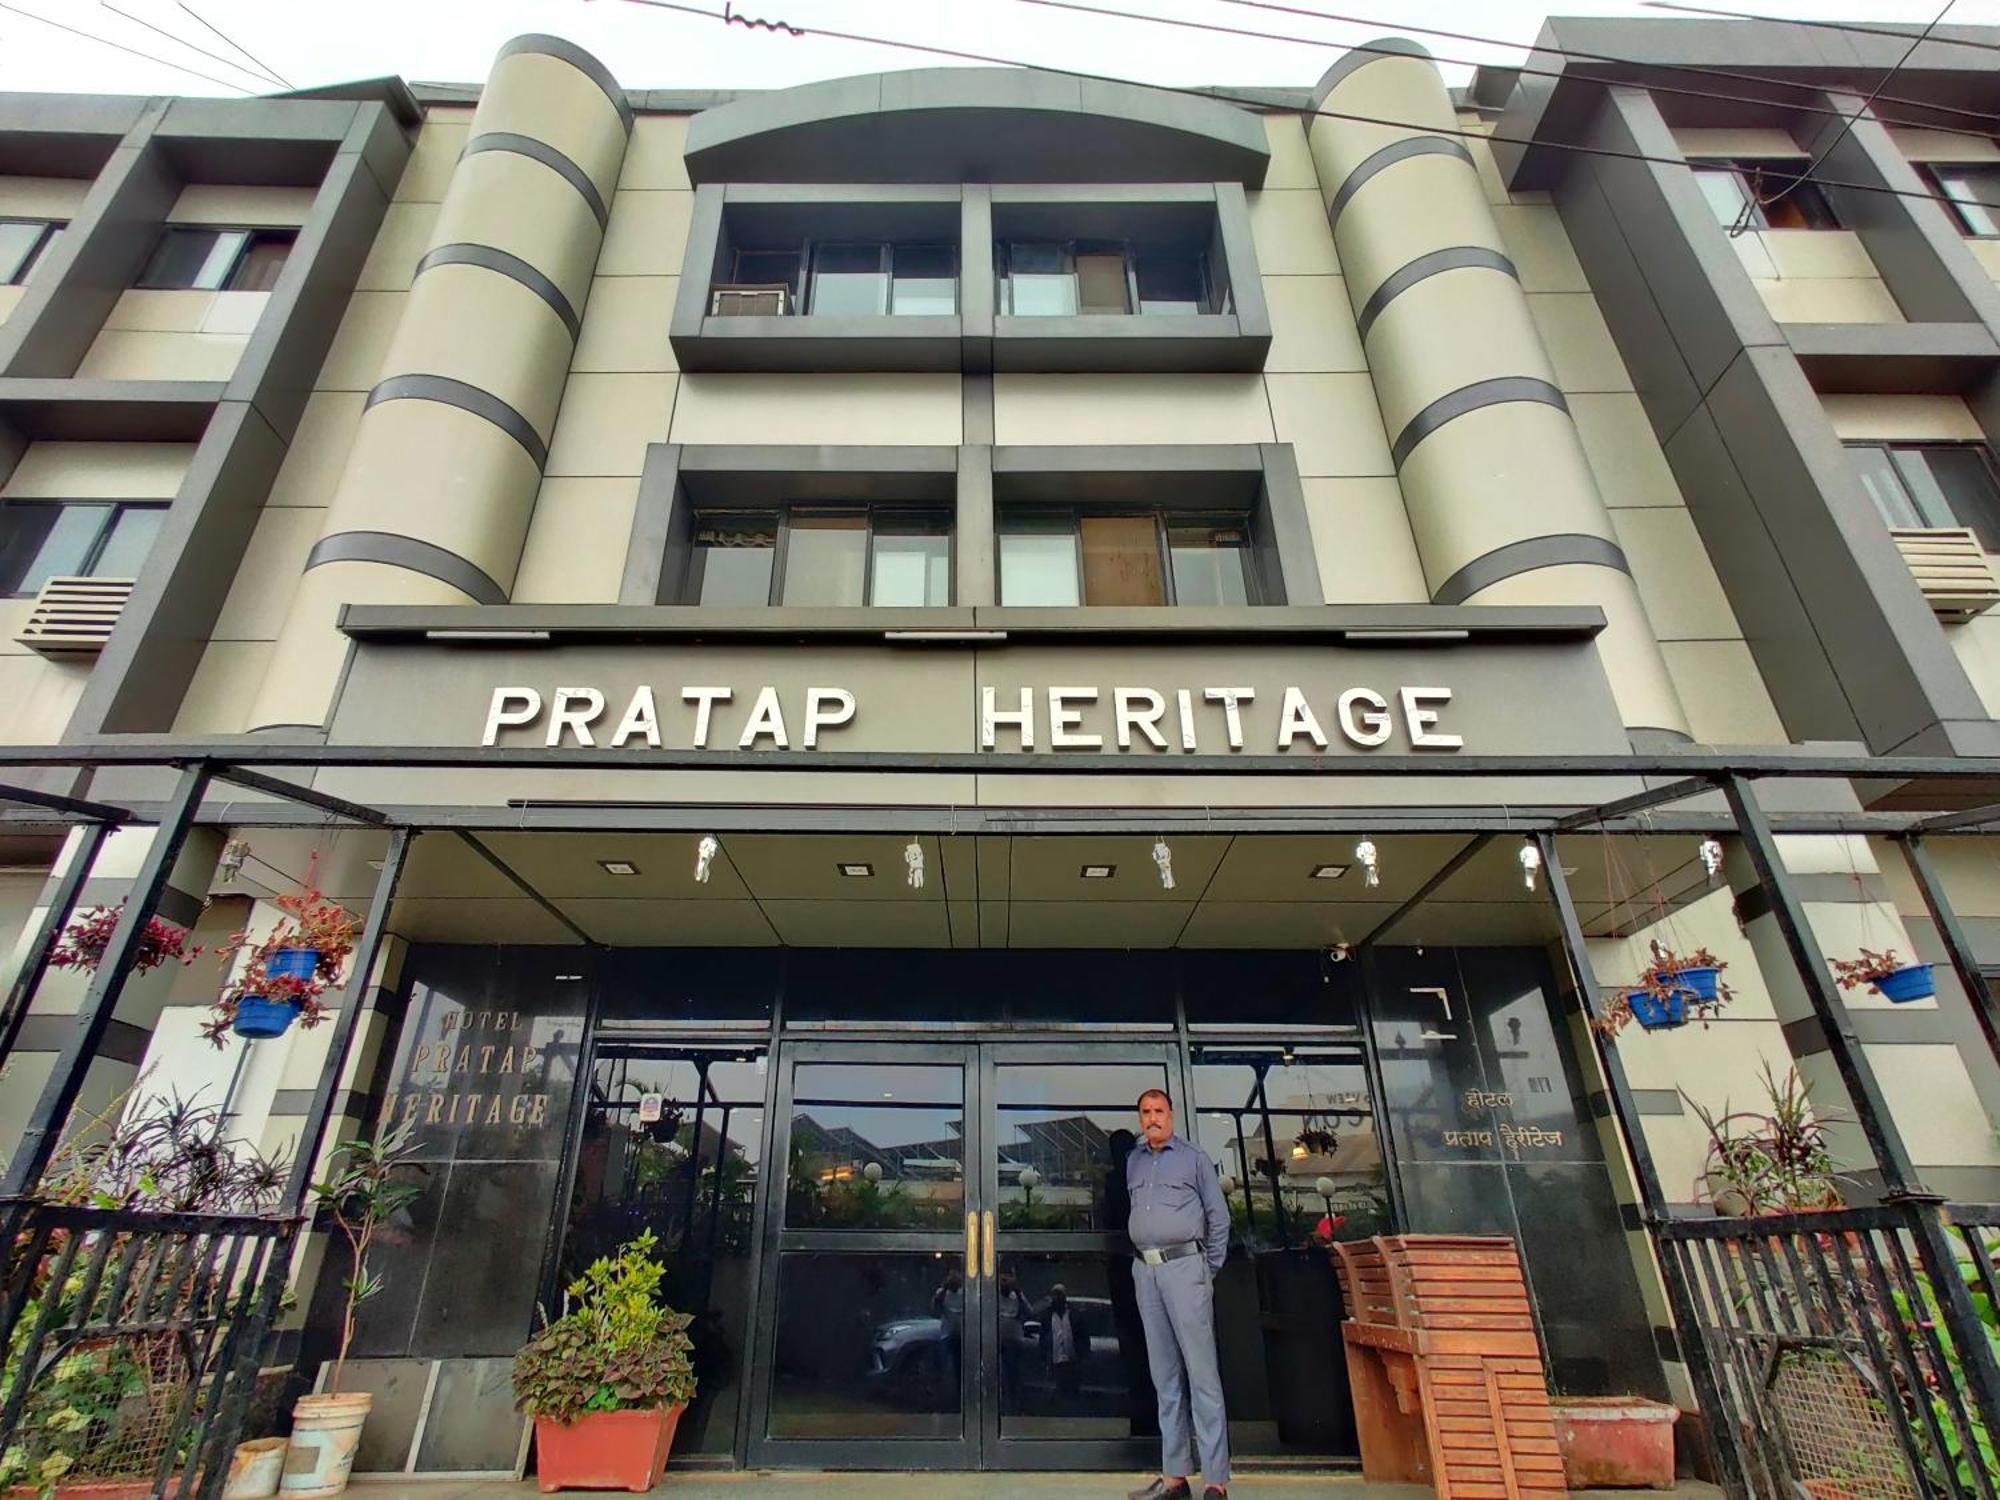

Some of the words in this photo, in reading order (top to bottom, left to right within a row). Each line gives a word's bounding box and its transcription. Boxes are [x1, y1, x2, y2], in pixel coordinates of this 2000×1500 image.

[482, 685, 856, 750] PRATAP
[982, 686, 1464, 752] HERITAGE
[445, 1011, 523, 1032] HOTEL
[411, 1043, 538, 1073] PRATAP
[1464, 1088, 1514, 1109] होटल
[1443, 1130, 1493, 1147] प्रताप
